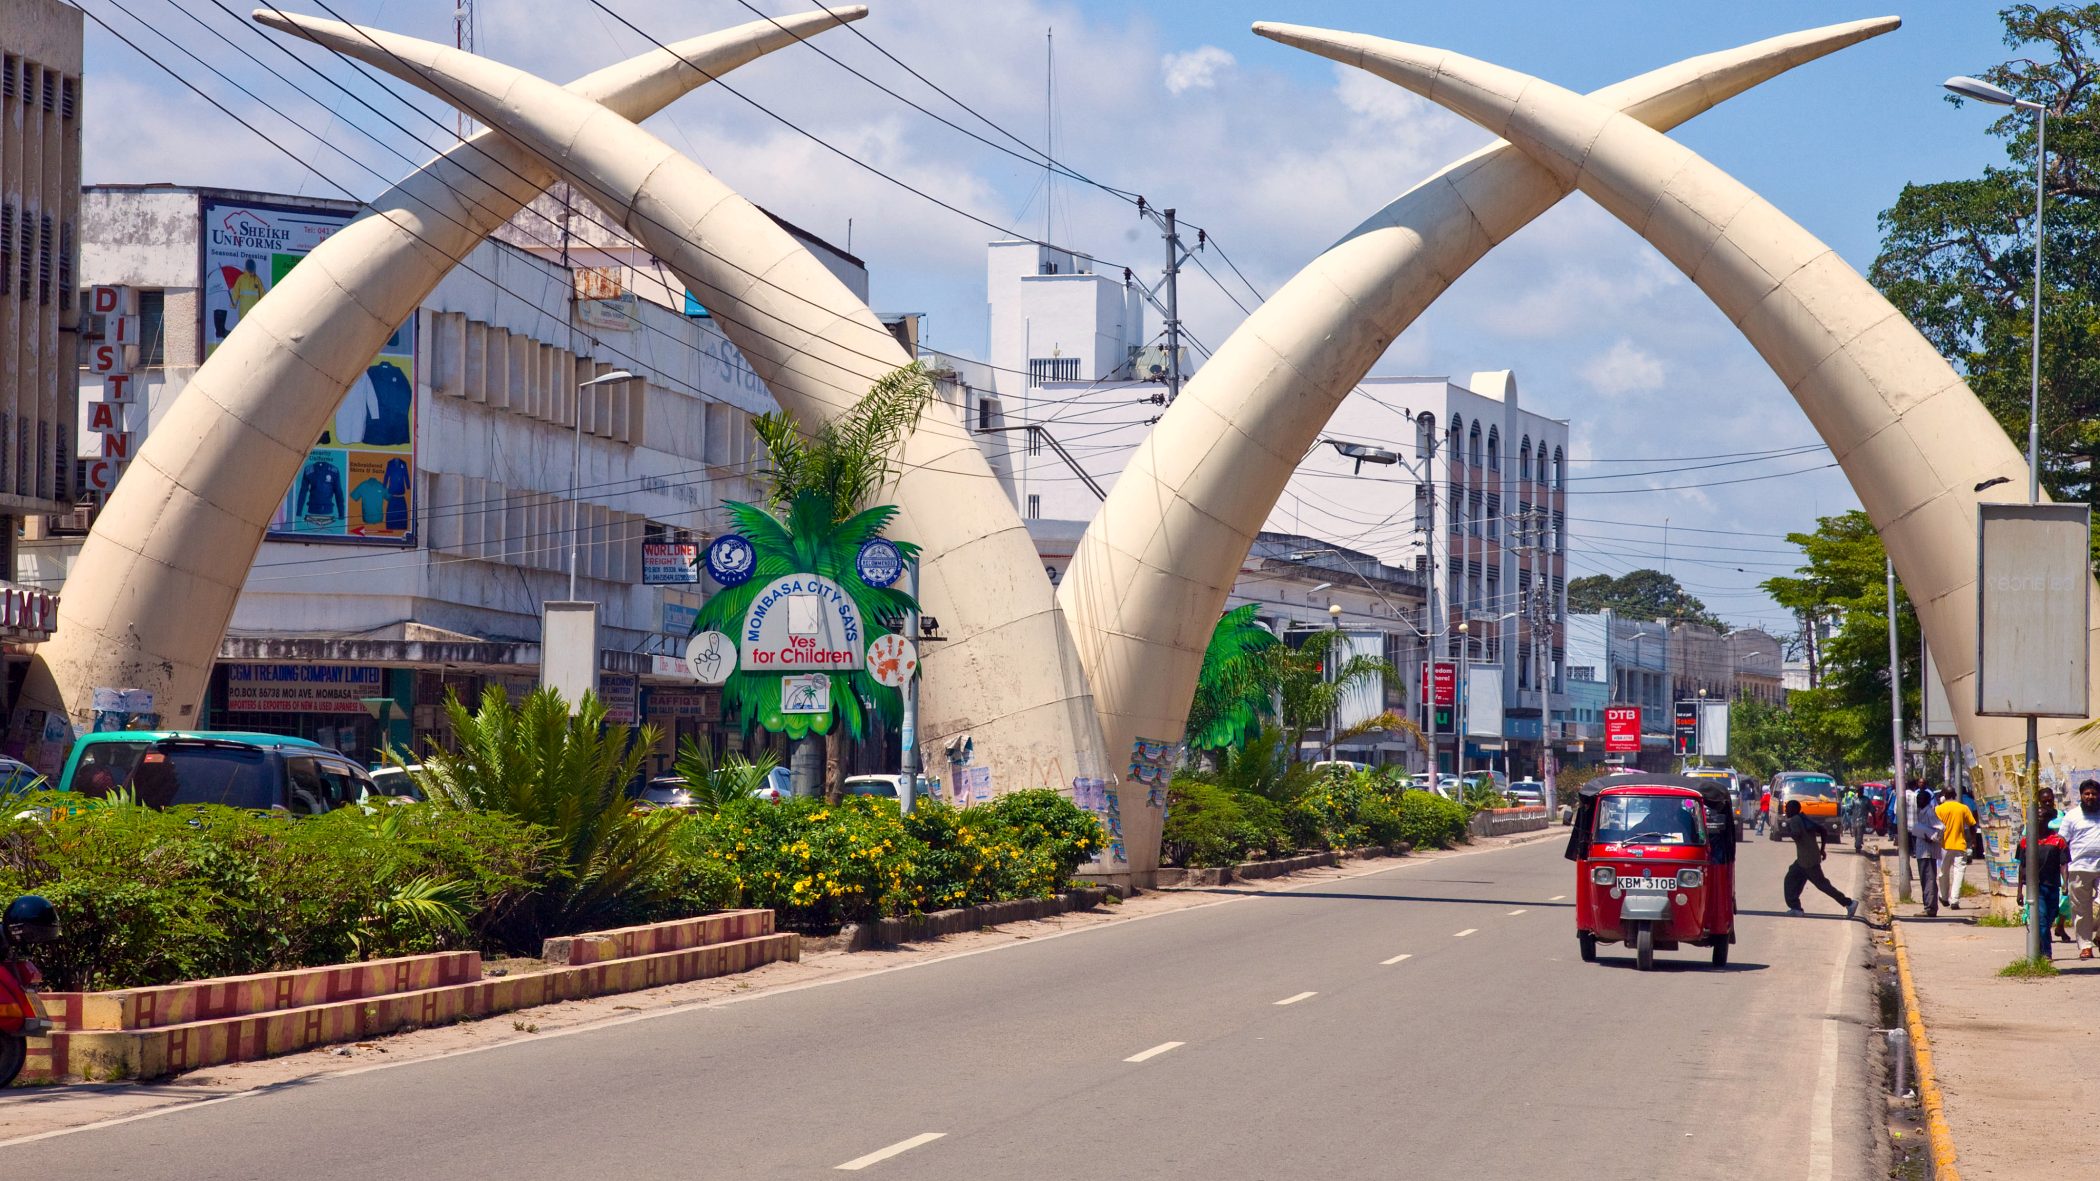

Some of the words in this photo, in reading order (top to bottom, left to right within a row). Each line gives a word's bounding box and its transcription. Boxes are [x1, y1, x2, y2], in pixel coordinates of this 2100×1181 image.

[240, 221, 290, 241] SHEIKH
[212, 229, 282, 250] UNIFORMS
[211, 249, 239, 258] Seasonal
[240, 252, 268, 261] Dressing
[91, 287, 127, 505] DISTANC
[645, 544, 697, 556] WORLDNET
[748, 580, 803, 641] MOMBASA
[807, 581, 842, 603] CITY
[838, 604, 858, 642] SAYS
[788, 635, 816, 648] Yes
[752, 648, 776, 663] for
[780, 648, 853, 664] Children
[300, 665, 344, 683] COMPANY
[345, 667, 380, 683] LIMITED
[315, 689, 352, 699] MOMBASA
[650, 695, 699, 706] RAFFIQ'S
[1608, 710, 1635, 720] DTB
[1617, 877, 1641, 889] KBM
[1646, 878, 1677, 890] 310B
